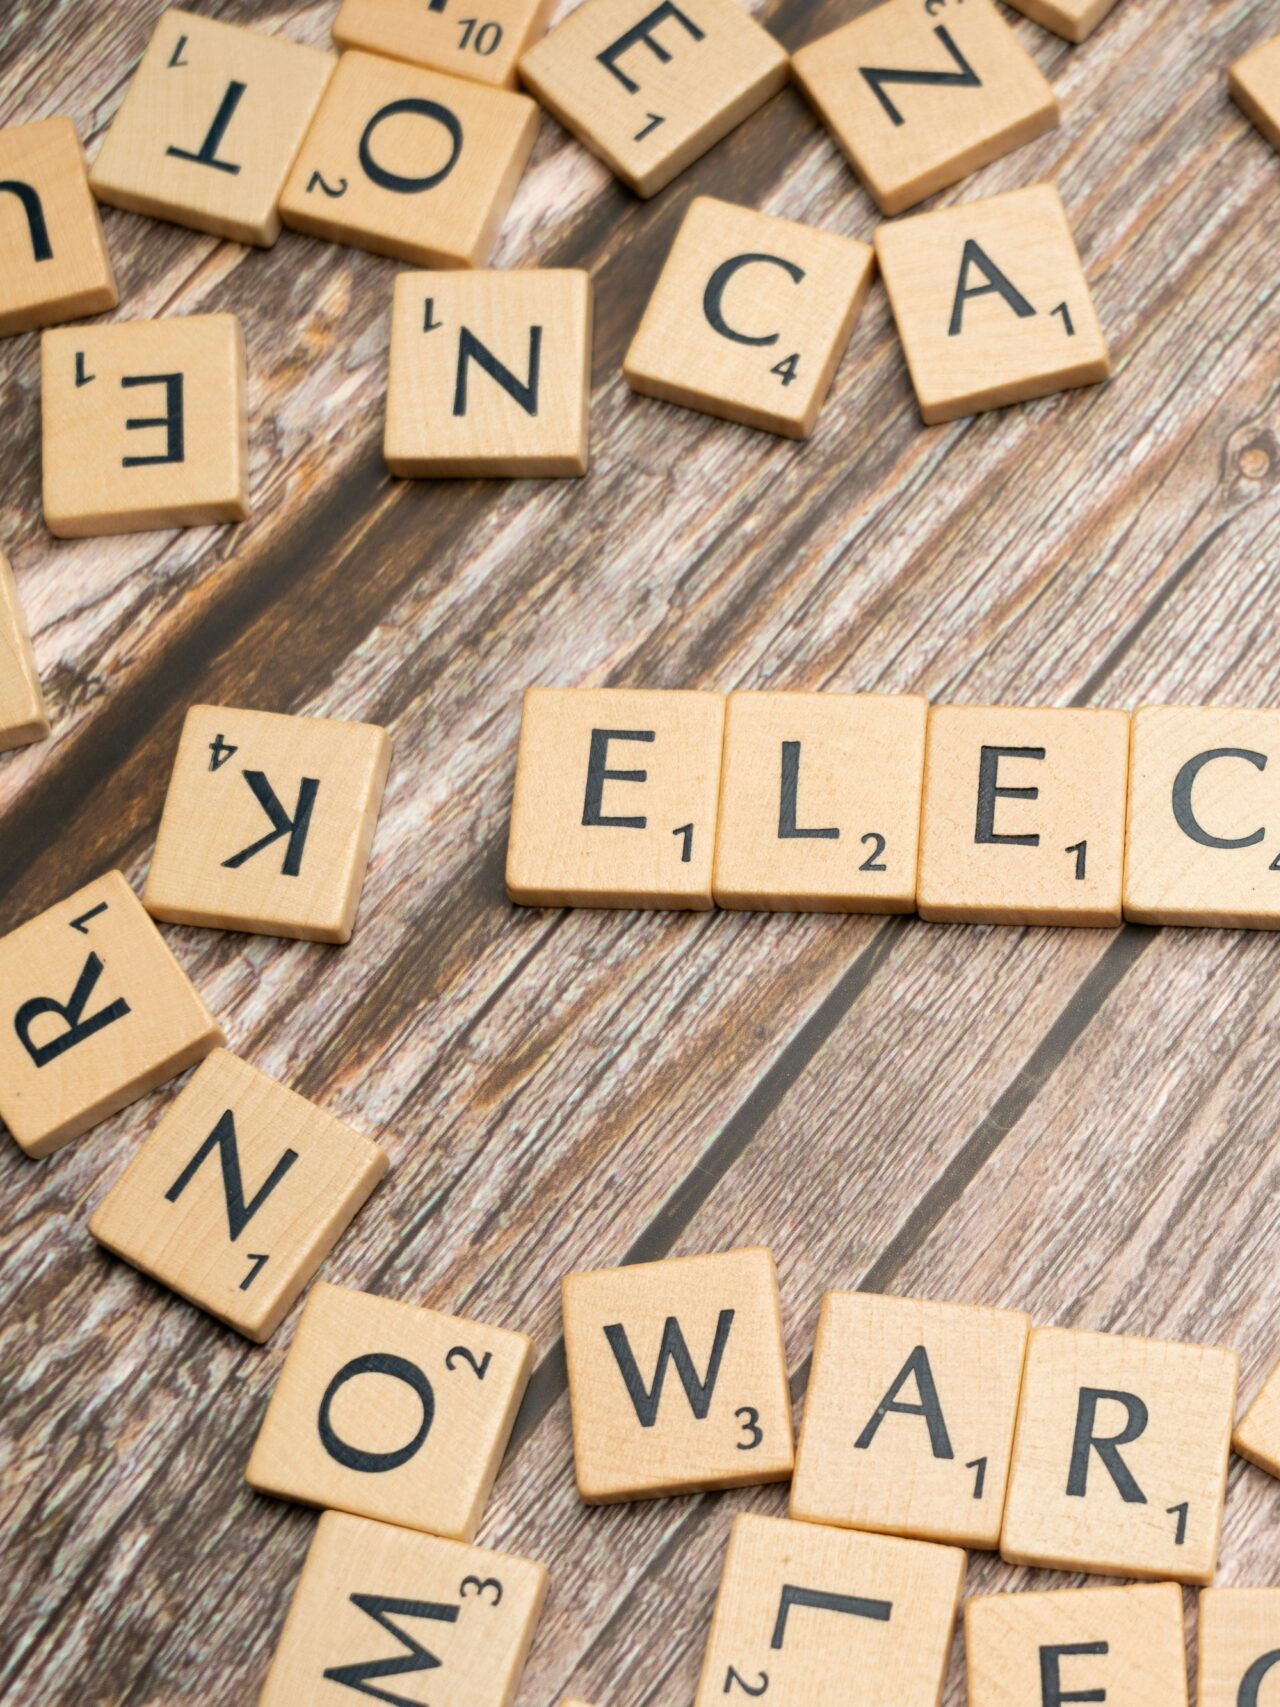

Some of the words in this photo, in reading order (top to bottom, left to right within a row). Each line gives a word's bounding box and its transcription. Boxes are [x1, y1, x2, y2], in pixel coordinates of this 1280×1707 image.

[168, 35, 187, 67] 1
[458, 19, 503, 55] 10
[595, 0, 705, 94] E
[166, 80, 246, 175] T
[358, 98, 463, 194] O
[634, 113, 665, 142] 1
[306, 171, 347, 198] 2
[423, 298, 442, 333] 1
[703, 253, 805, 347] C
[770, 353, 800, 386] 4
[948, 239, 1037, 336] A
[1050, 302, 1075, 336] 1
[75, 352, 95, 387] 1
[453, 326, 542, 416] N
[121, 373, 184, 467] E
[209, 734, 238, 771] 4
[221, 770, 320, 877] K
[672, 823, 694, 862] 1
[859, 833, 886, 871] 2
[1065, 840, 1087, 880] 1
[69, 902, 108, 934] 1
[14, 951, 131, 1068] R
[239, 1254, 269, 1291] 1
[317, 1353, 435, 1473] O
[445, 1346, 492, 1380] 2
[603, 1309, 735, 1427] W
[734, 1407, 763, 1450] 3
[854, 1345, 954, 1460] A
[965, 1457, 987, 1499] 1
[1066, 1387, 1148, 1504] R
[1166, 1502, 1188, 1545] 1
[460, 1575, 503, 1606] 3
[770, 1584, 893, 1650] L
[723, 1665, 769, 1697] 2
